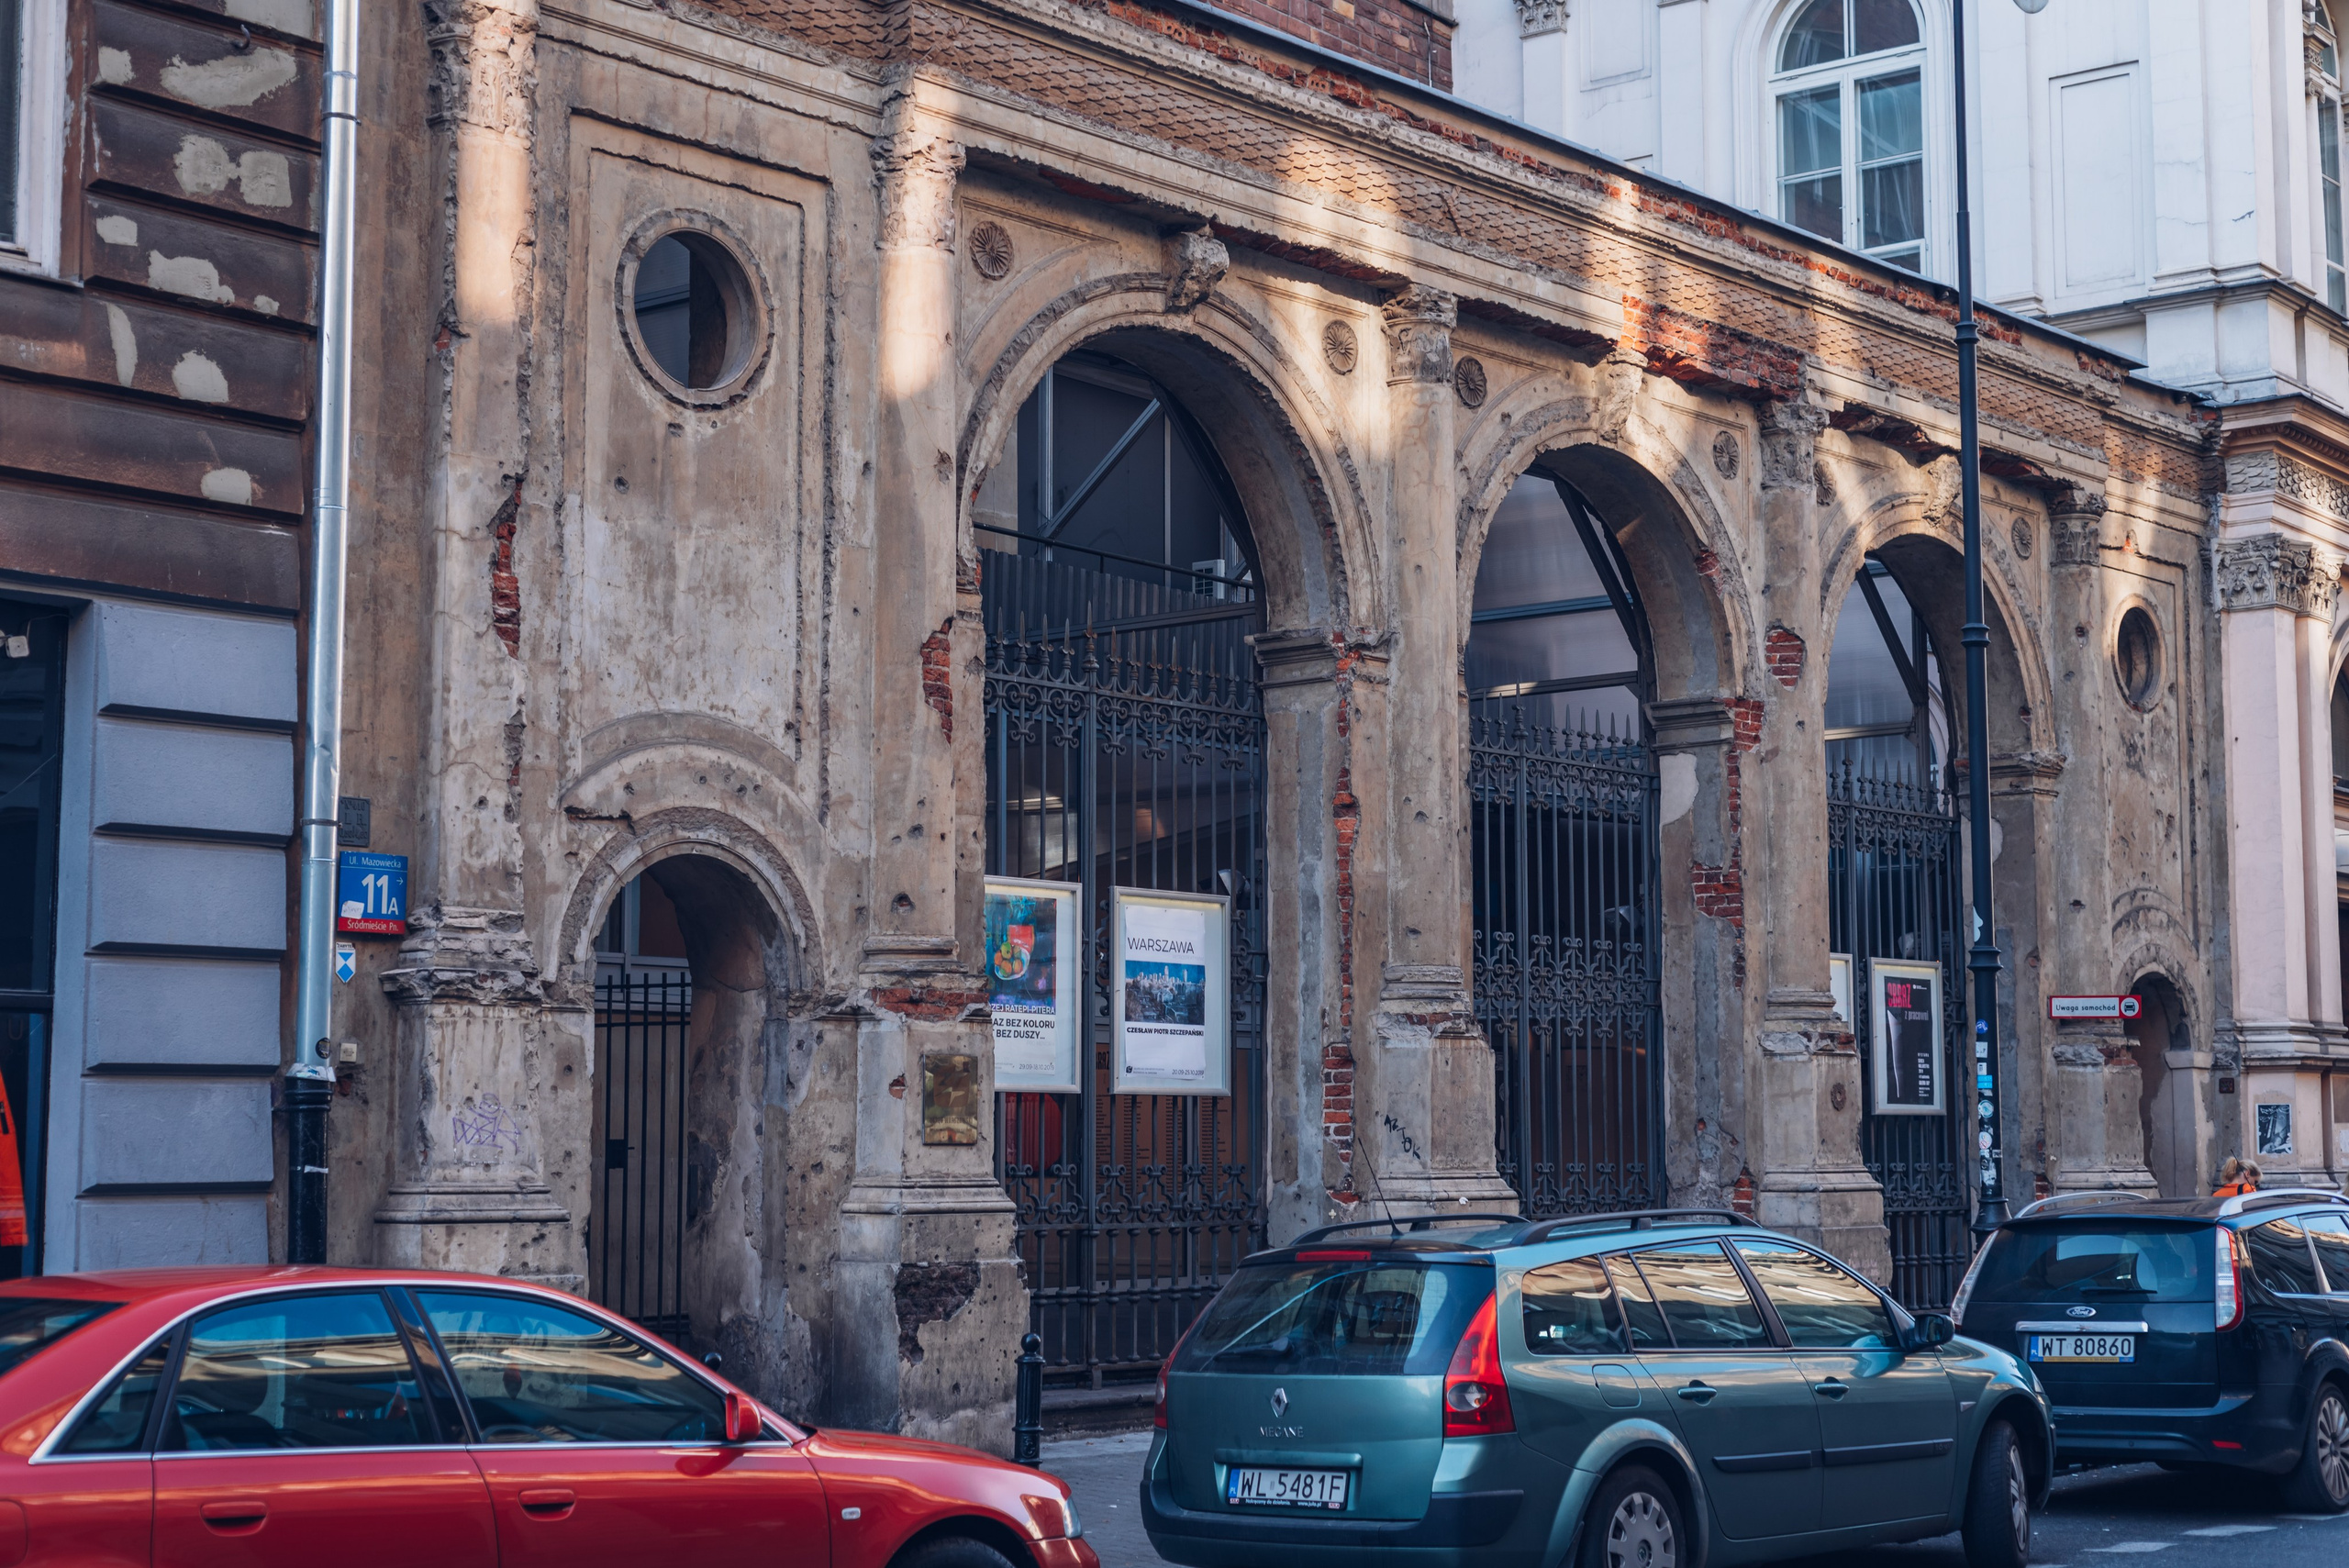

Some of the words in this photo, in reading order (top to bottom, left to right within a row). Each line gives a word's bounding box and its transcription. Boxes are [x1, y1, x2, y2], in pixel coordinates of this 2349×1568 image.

[349, 855, 359, 865] Ul.
[362, 856, 402, 868] Mazowiecka
[361, 873, 399, 916] 11A
[347, 917, 387, 931] Śródmieście
[388, 921, 399, 931] Pn.
[1127, 937, 1195, 954] WARSZAWA
[991, 1003, 1004, 1012] ZEJ
[1006, 1005, 1055, 1015] RATEPI-PITERA
[2055, 1004, 2079, 1013] Uwaga
[993, 1018, 1005, 1027] AZ
[1006, 1018, 1021, 1028] BEZ
[1022, 1019, 1055, 1029] KOLORU
[996, 1029, 1012, 1038] BEZ
[1169, 1029, 1205, 1037] SZCZEPAŃSKI
[2071, 1307, 2090, 1316] Ford
[2042, 1338, 2066, 1356] WT
[2074, 1338, 2132, 1356] 80860
[1260, 1426, 1304, 1438] MEGANE
[1230, 1486, 1237, 1495] PL
[1241, 1472, 1266, 1497] WL
[1275, 1473, 1343, 1500] 5481F
